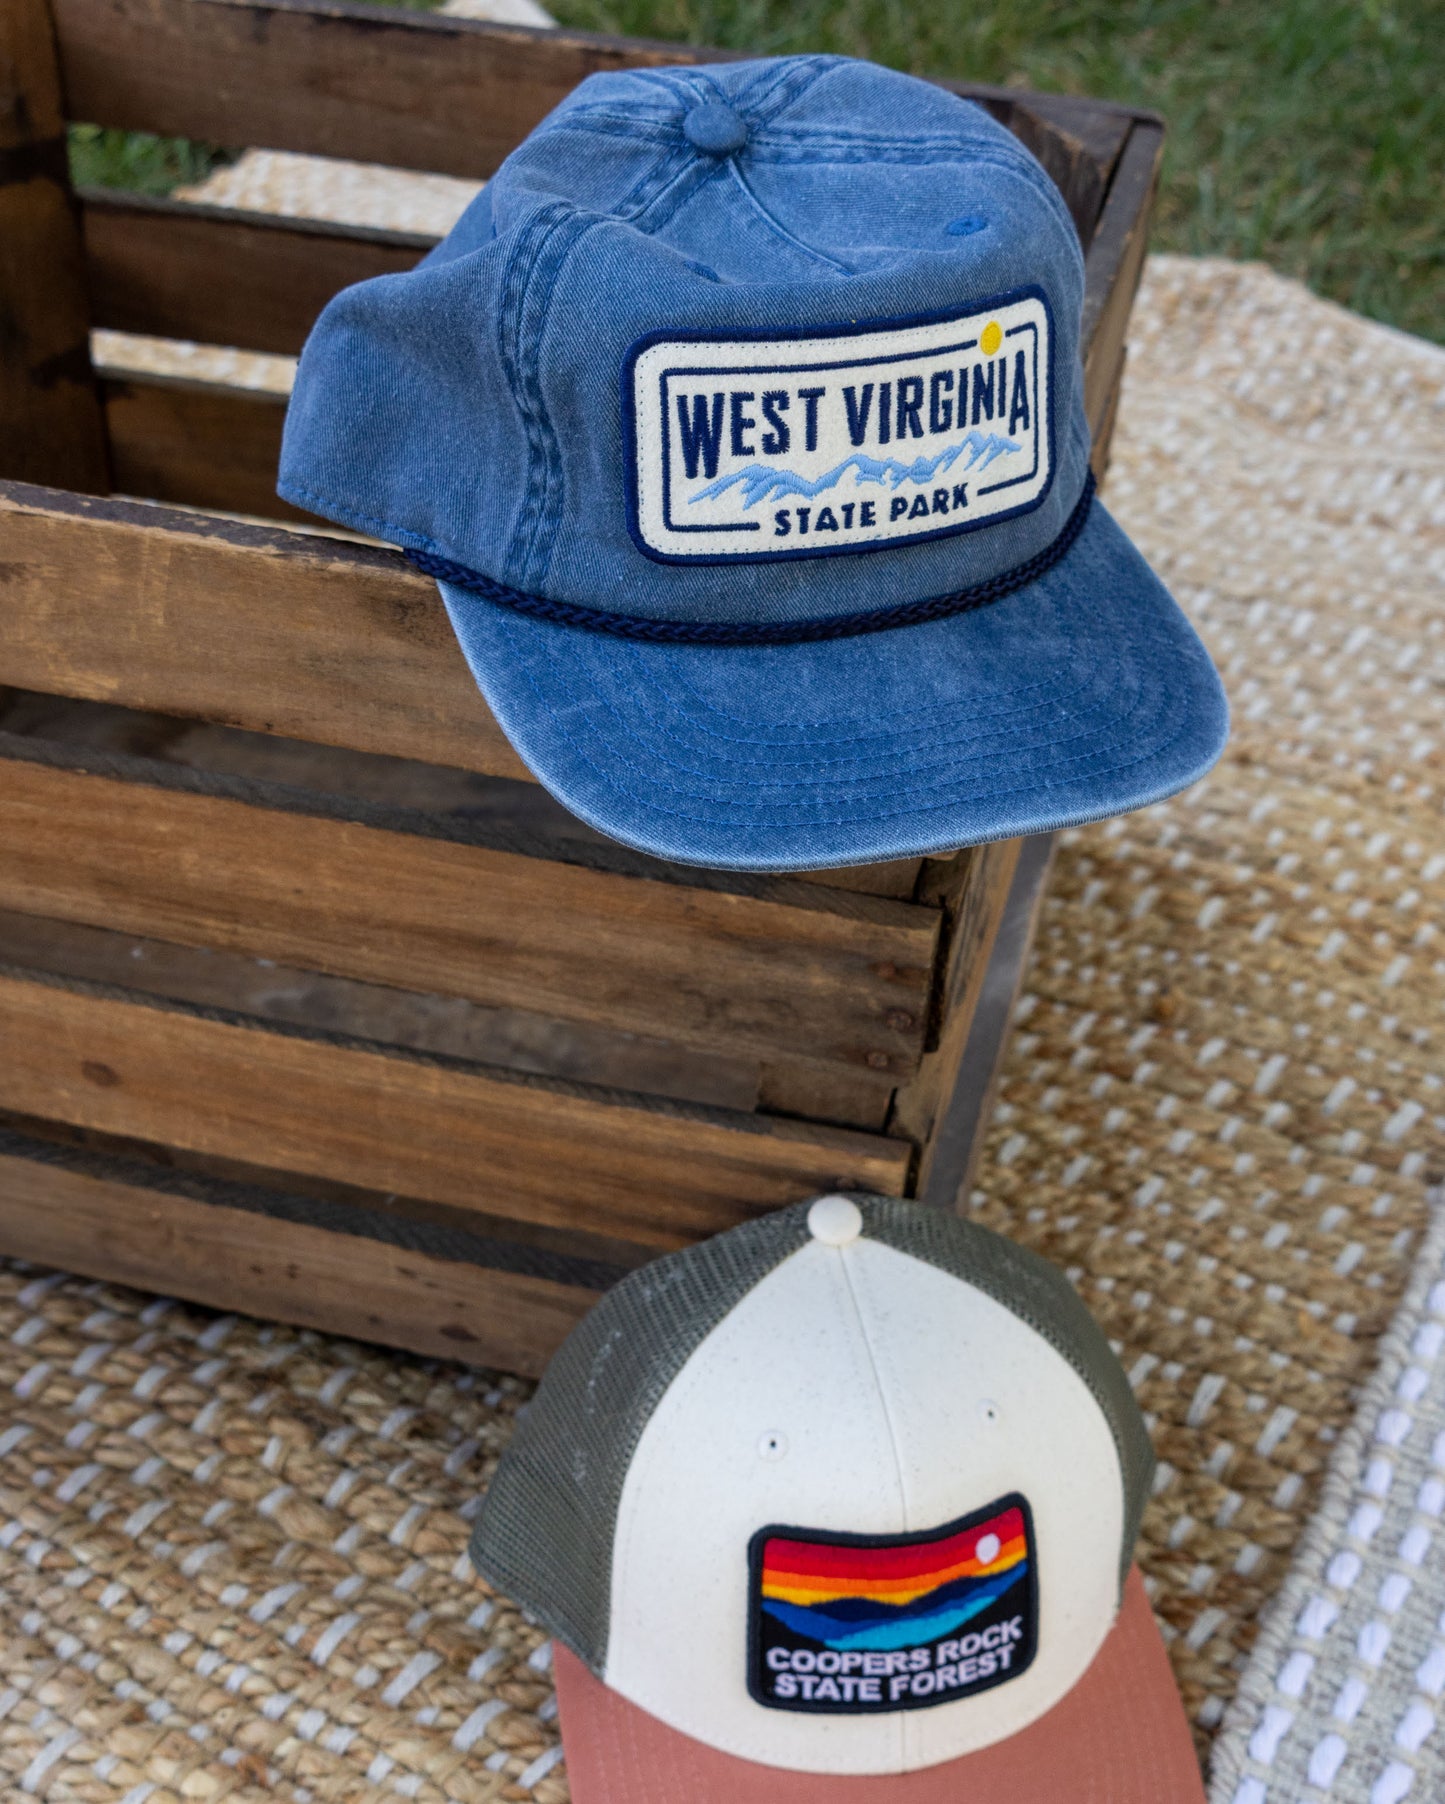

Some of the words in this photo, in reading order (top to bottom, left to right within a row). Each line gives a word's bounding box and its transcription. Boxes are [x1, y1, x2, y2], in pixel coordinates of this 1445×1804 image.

[677, 386, 825, 479] WEST
[842, 350, 1031, 446] VIRGINIA
[774, 501, 876, 536] STATE
[890, 482, 969, 521] PARK
[766, 1647, 931, 1675] COOPERS
[937, 1615, 1023, 1665] ROCK
[774, 1673, 883, 1702] STATE
[890, 1642, 1016, 1700] FOREST
